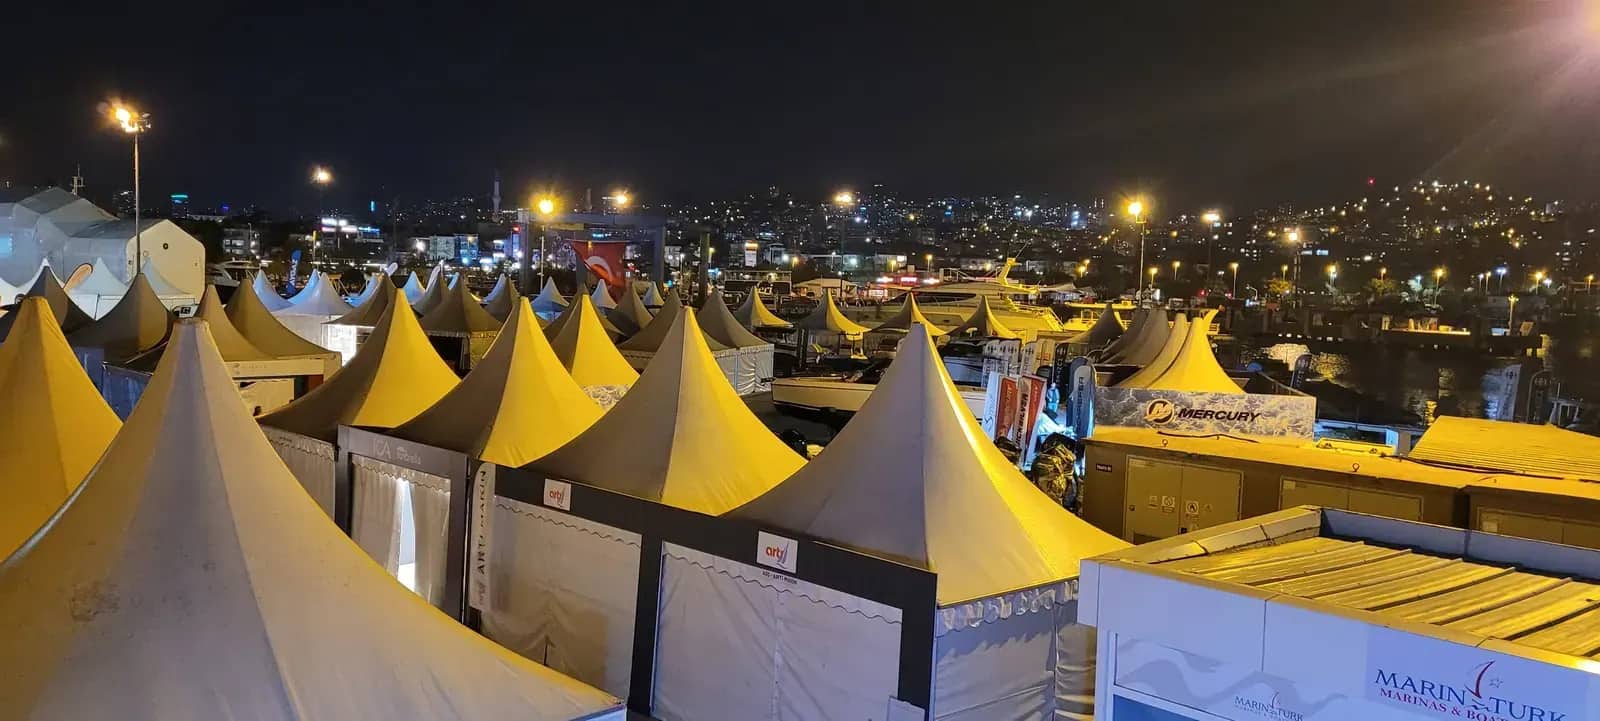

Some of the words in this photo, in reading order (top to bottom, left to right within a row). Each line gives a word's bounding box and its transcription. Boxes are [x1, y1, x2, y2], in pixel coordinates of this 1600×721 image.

[1178, 408, 1261, 423] MERCURY
[1234, 695, 1269, 713] MARIN
[1277, 707, 1304, 721] TURK
[1375, 668, 1466, 706] MARIN
[1489, 696, 1567, 721] TURK
[1380, 687, 1447, 714] MARINAS
[1451, 706, 1461, 717] &
